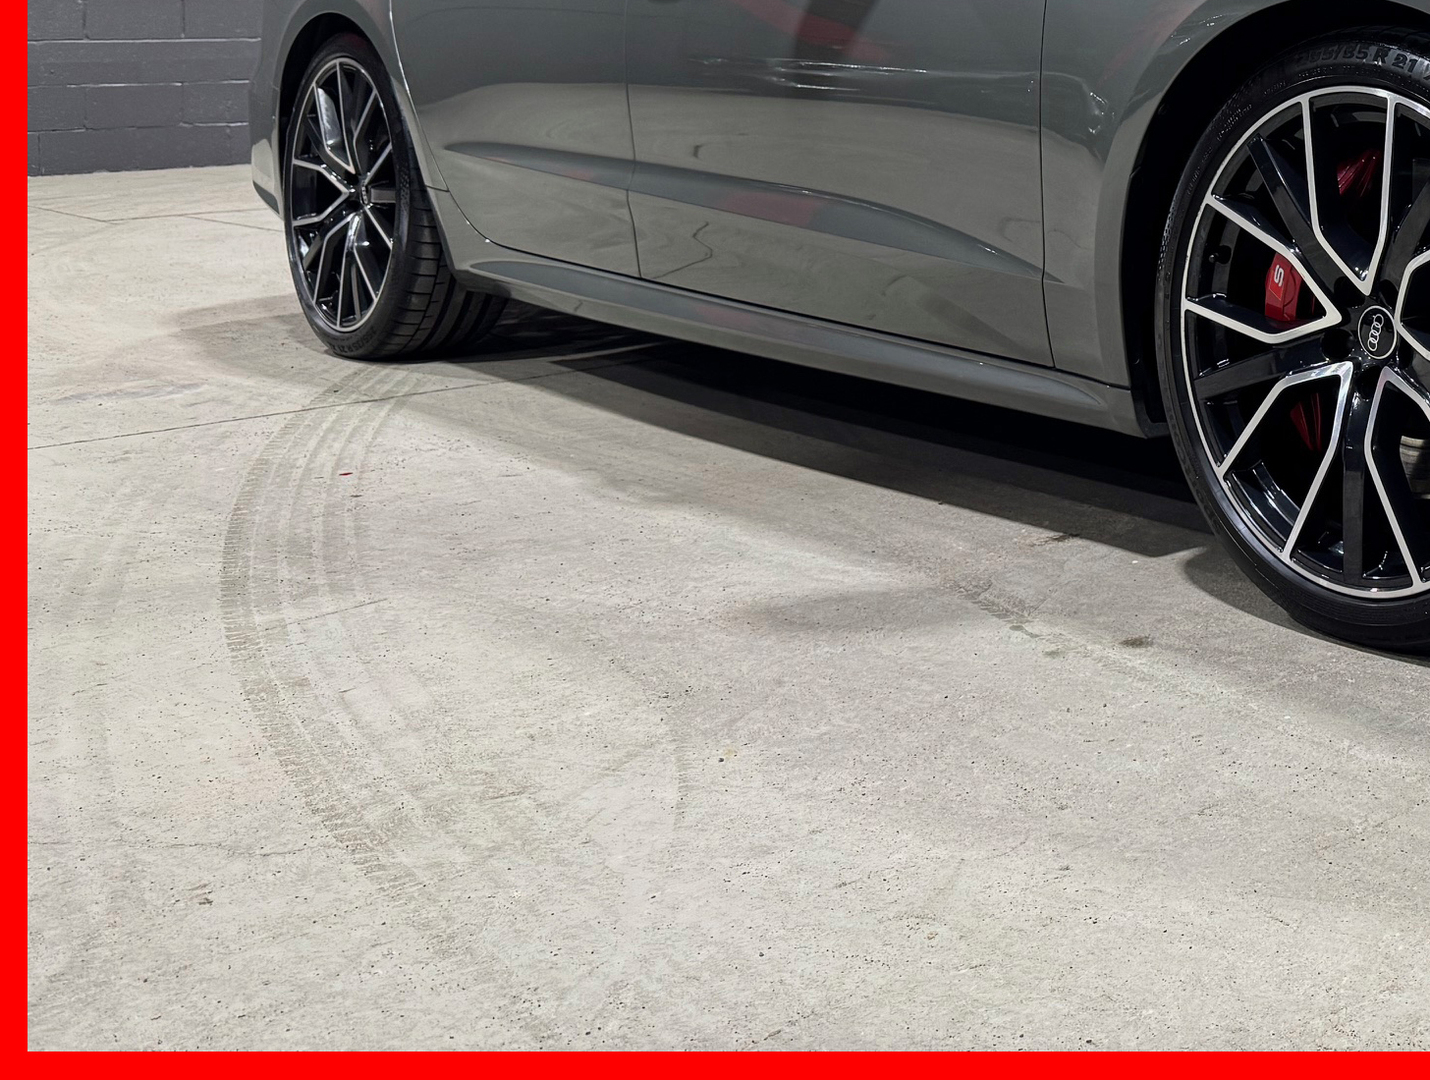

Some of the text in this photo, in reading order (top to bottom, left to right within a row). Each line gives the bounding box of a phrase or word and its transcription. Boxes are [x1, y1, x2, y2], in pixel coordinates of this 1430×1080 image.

[1372, 47, 1391, 64] R
[1392, 53, 1418, 73] 21
[1273, 264, 1284, 287] S
